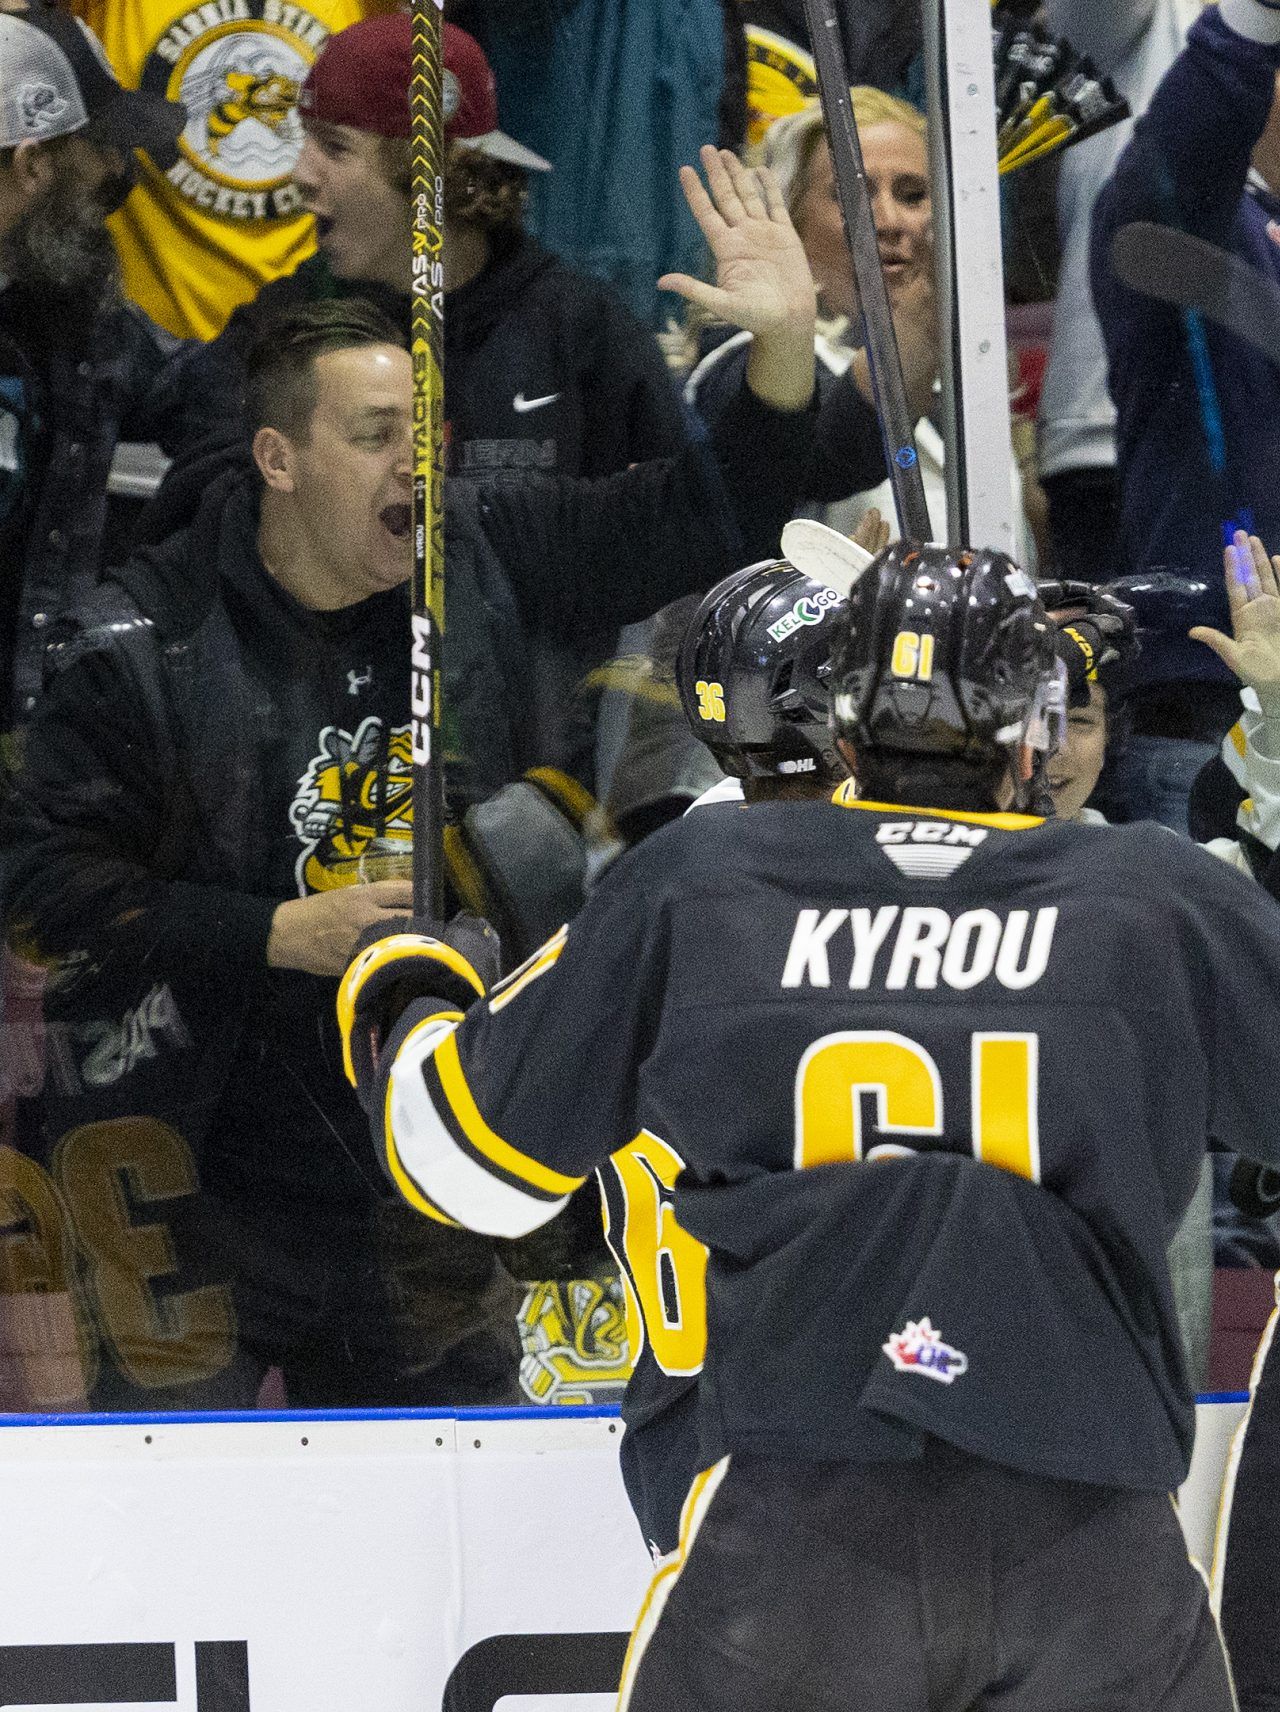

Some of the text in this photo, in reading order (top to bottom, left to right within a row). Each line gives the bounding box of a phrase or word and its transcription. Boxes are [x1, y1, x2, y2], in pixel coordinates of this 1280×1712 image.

[434, 175, 443, 226] PRO
[892, 631, 936, 682] 61
[411, 614, 431, 766] CCM
[695, 680, 726, 722] 36
[876, 821, 988, 848] CCM
[781, 905, 1058, 990] KYROU
[595, 1128, 711, 1377] 6
